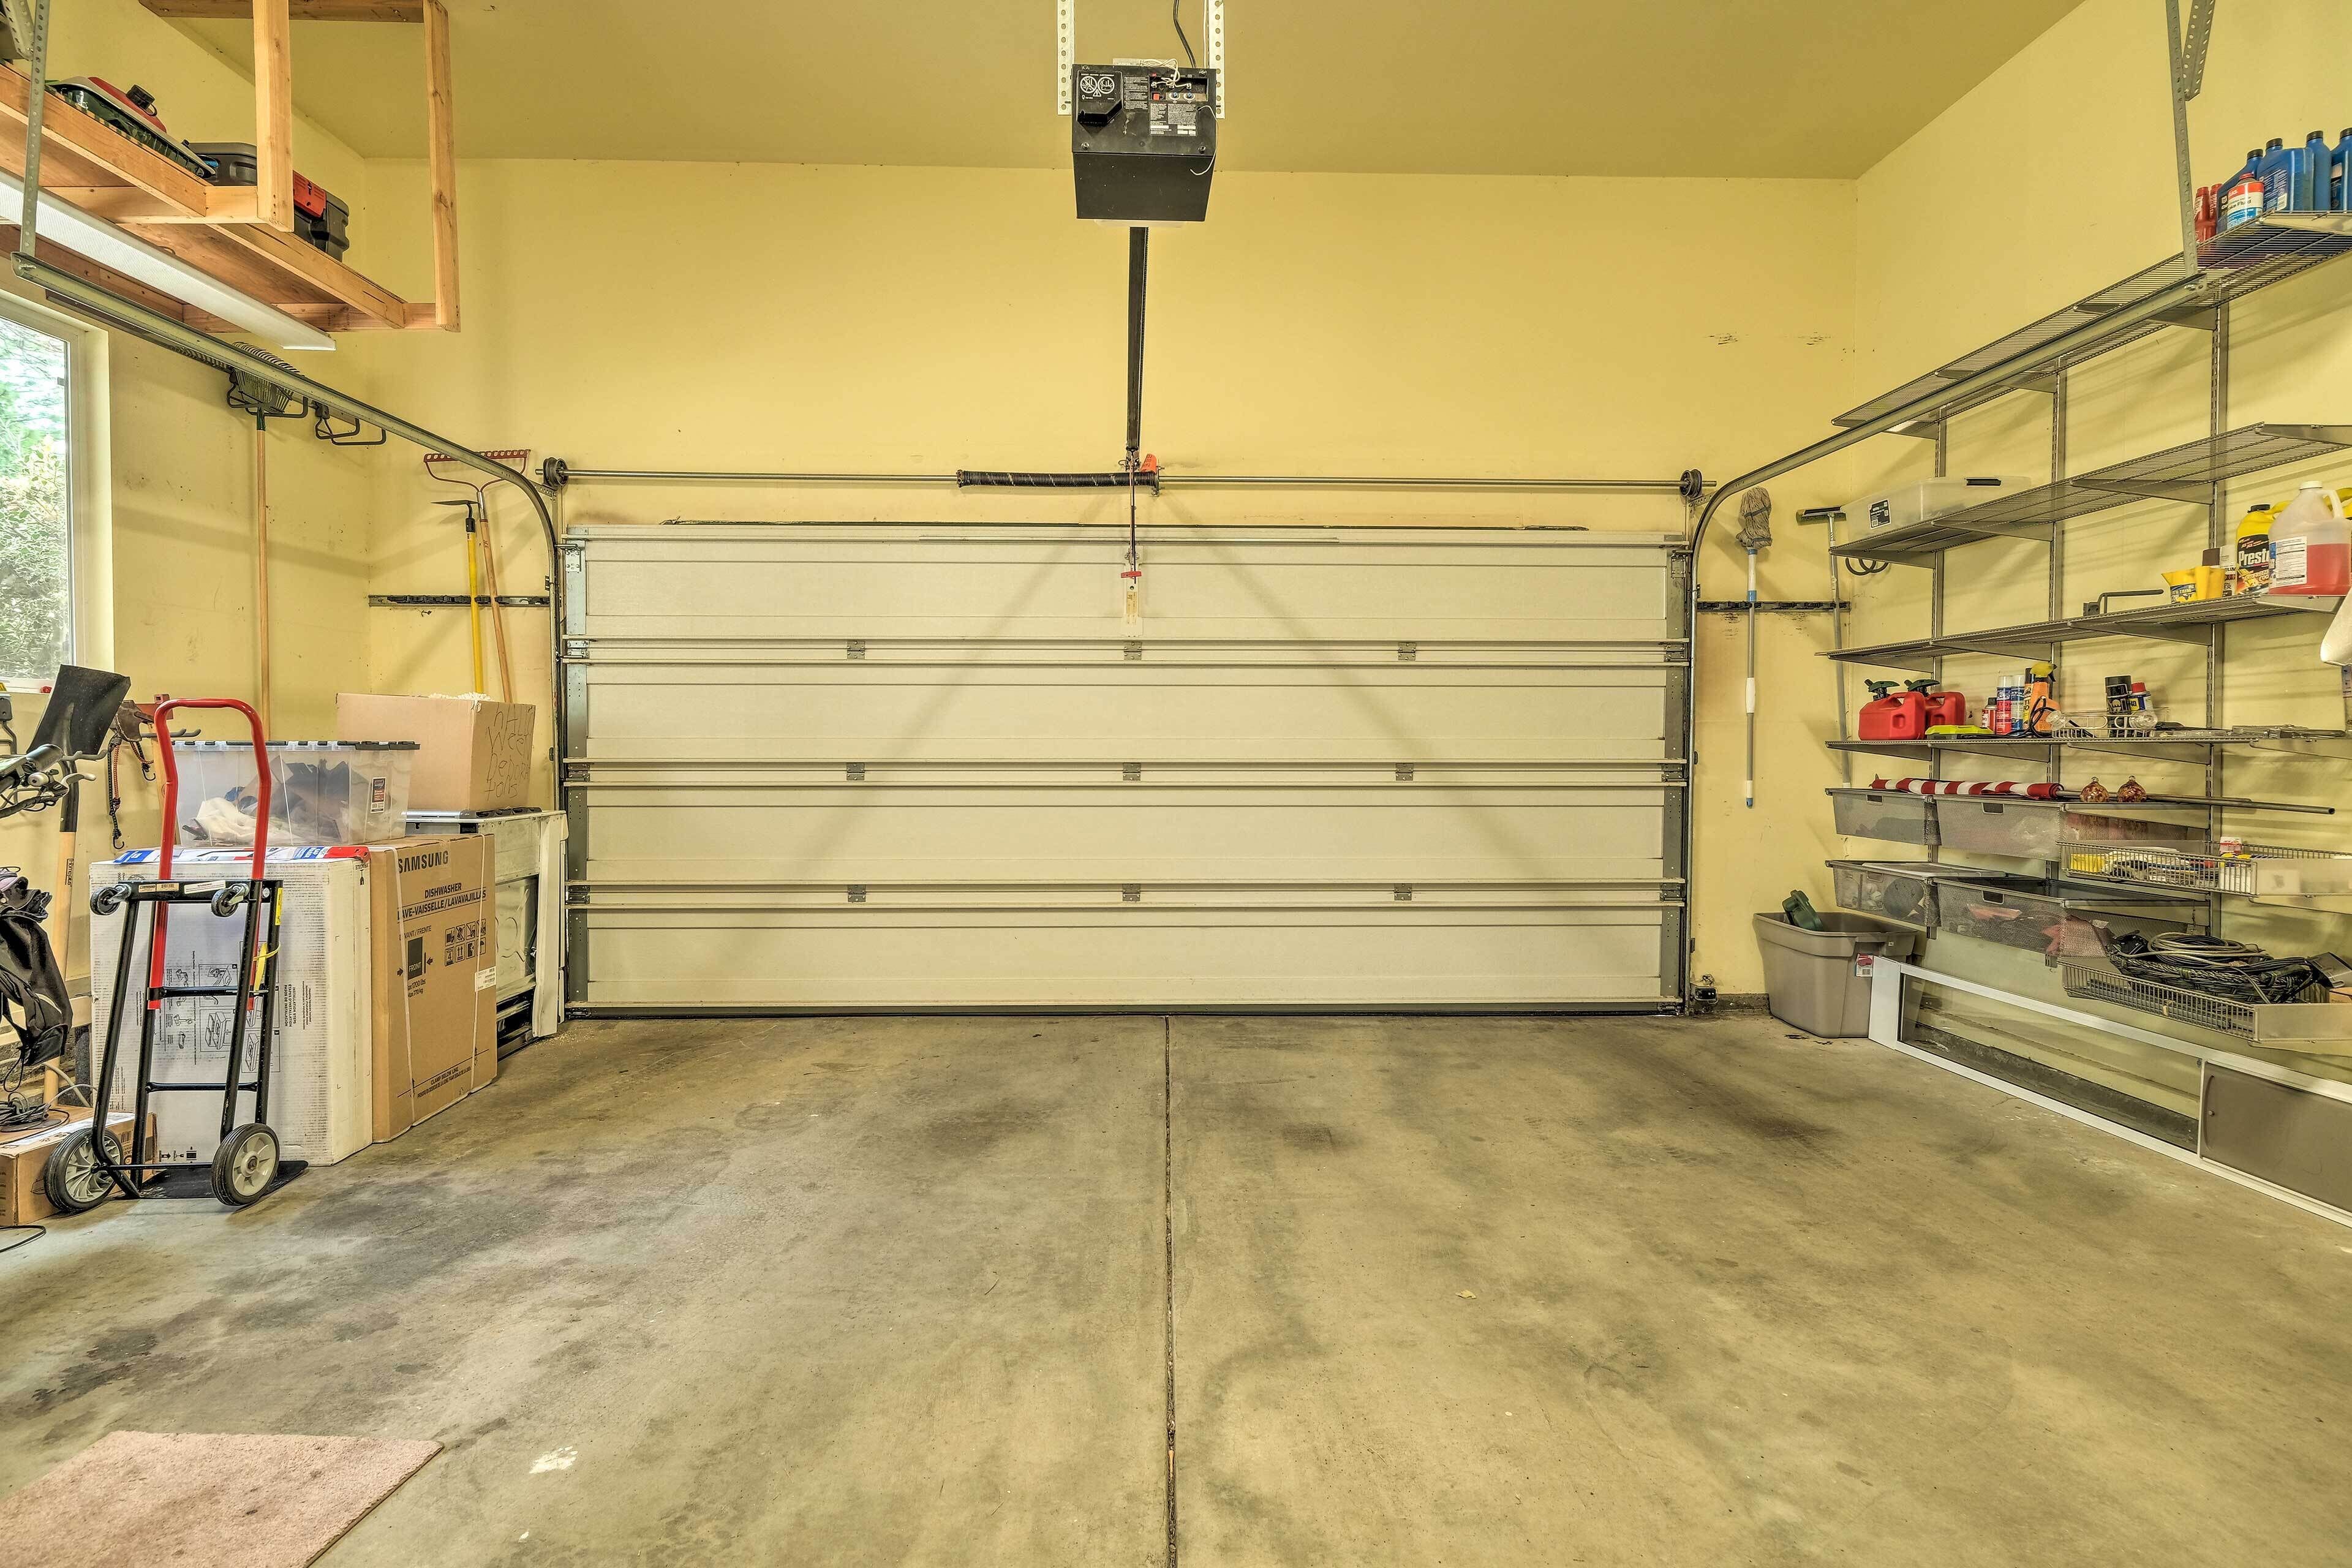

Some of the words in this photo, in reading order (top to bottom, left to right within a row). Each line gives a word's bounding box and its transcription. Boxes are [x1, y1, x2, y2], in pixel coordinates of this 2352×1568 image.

[2238, 548, 2269, 567] Prest
[398, 850, 448, 873] SAMSUNG
[424, 883, 462, 899] DISHWASHER
[409, 962, 421, 972] FRONT
